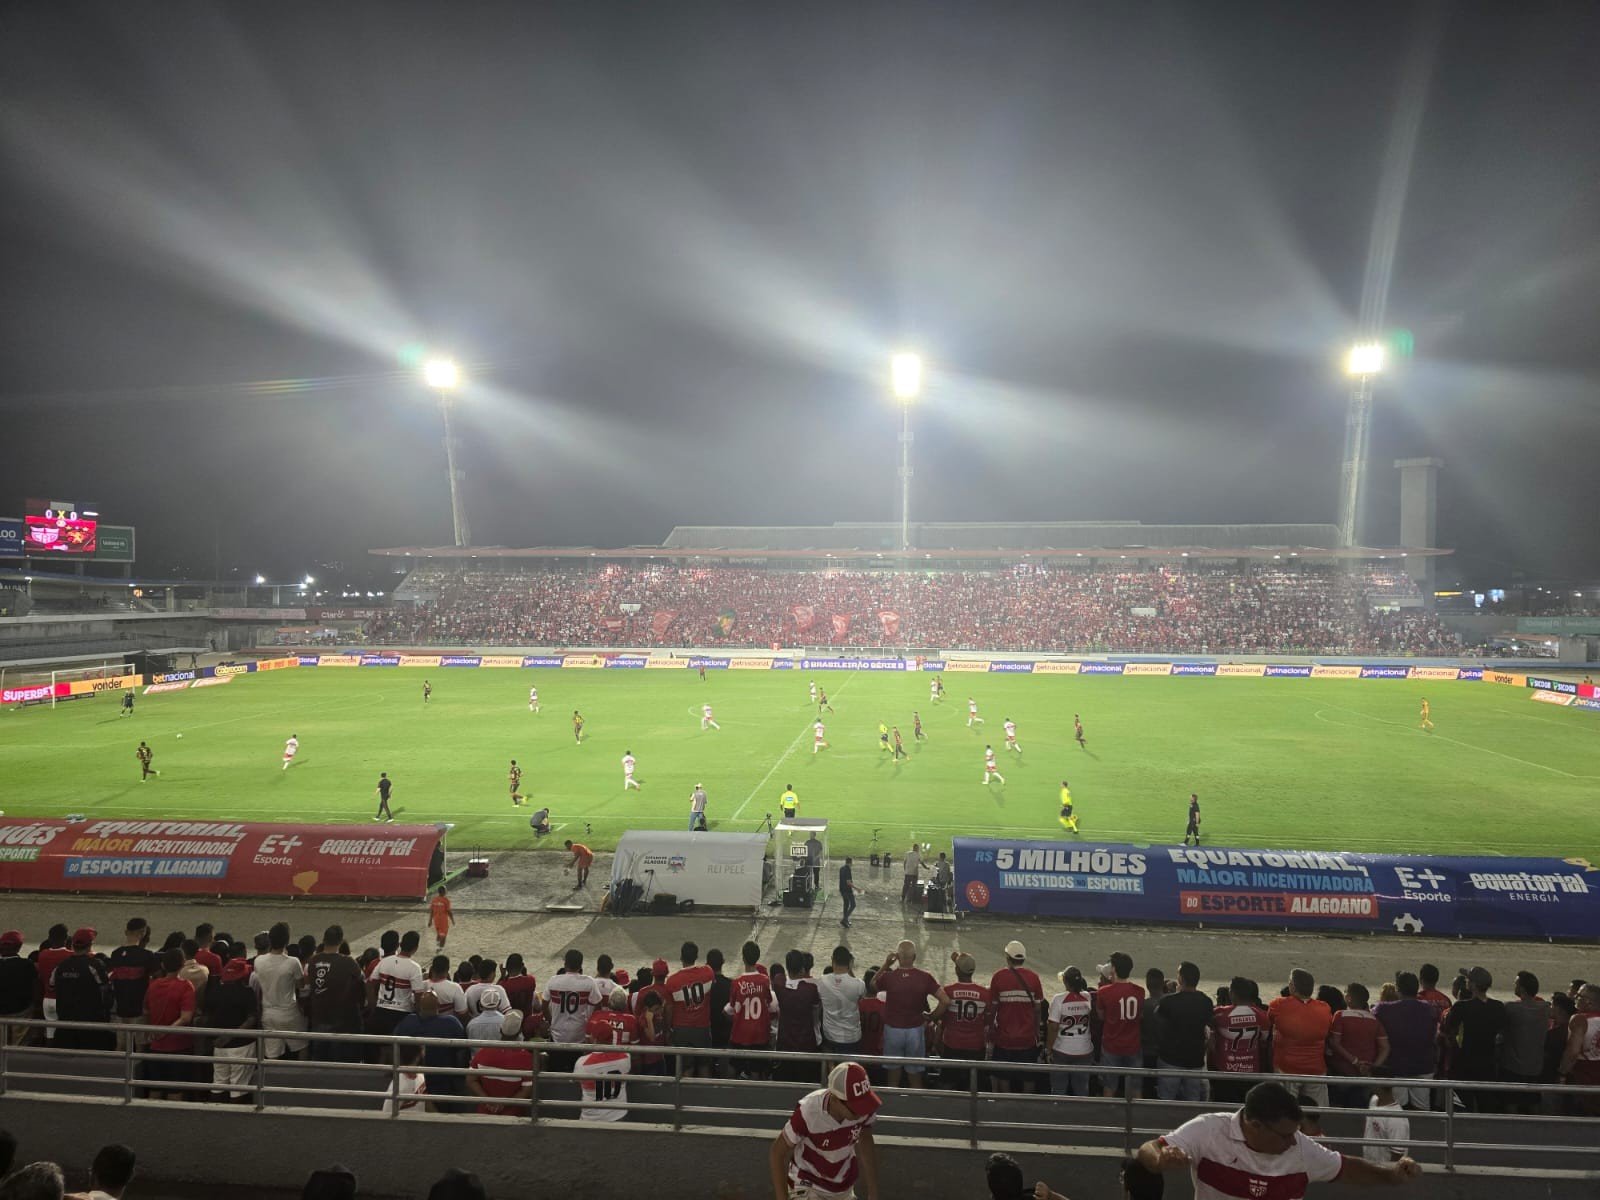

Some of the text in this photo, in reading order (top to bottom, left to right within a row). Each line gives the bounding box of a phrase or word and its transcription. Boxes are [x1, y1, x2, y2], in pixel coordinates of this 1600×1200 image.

[45, 509, 52, 519] 0
[70, 511, 77, 521] 0
[92, 679, 123, 690] vonder
[152, 670, 195, 684] betnacional
[3, 686, 54, 700] SUPERBET
[72, 838, 238, 856] MAIOR INCENTIVADORA
[318, 837, 417, 857] equatorial
[69, 860, 224, 875] DO ESPORTE ALAGOANO
[253, 854, 293, 866] Esporte
[341, 856, 381, 865] ENERGIA
[975, 848, 1147, 875] R$ 5 MILHÕES
[1004, 873, 1074, 889] INVESTIDOS
[1087, 876, 1141, 892] ESPORTE
[1176, 869, 1375, 893] MAIOR INCENTIVADORA
[1468, 872, 1590, 894] equatorial
[1187, 894, 1372, 915] DO ESPORTE ALAGOANO
[1404, 889, 1452, 903] Esporte
[1510, 892, 1559, 902] ENERGIA
[383, 976, 396, 1001] 9
[682, 982, 704, 1008] 10
[560, 991, 580, 1014] 10
[742, 996, 762, 1020] 10
[954, 1000, 978, 1021] 10
[1119, 996, 1138, 1021] 10
[1229, 1026, 1260, 1051] 77
[595, 1070, 622, 1102] 10
